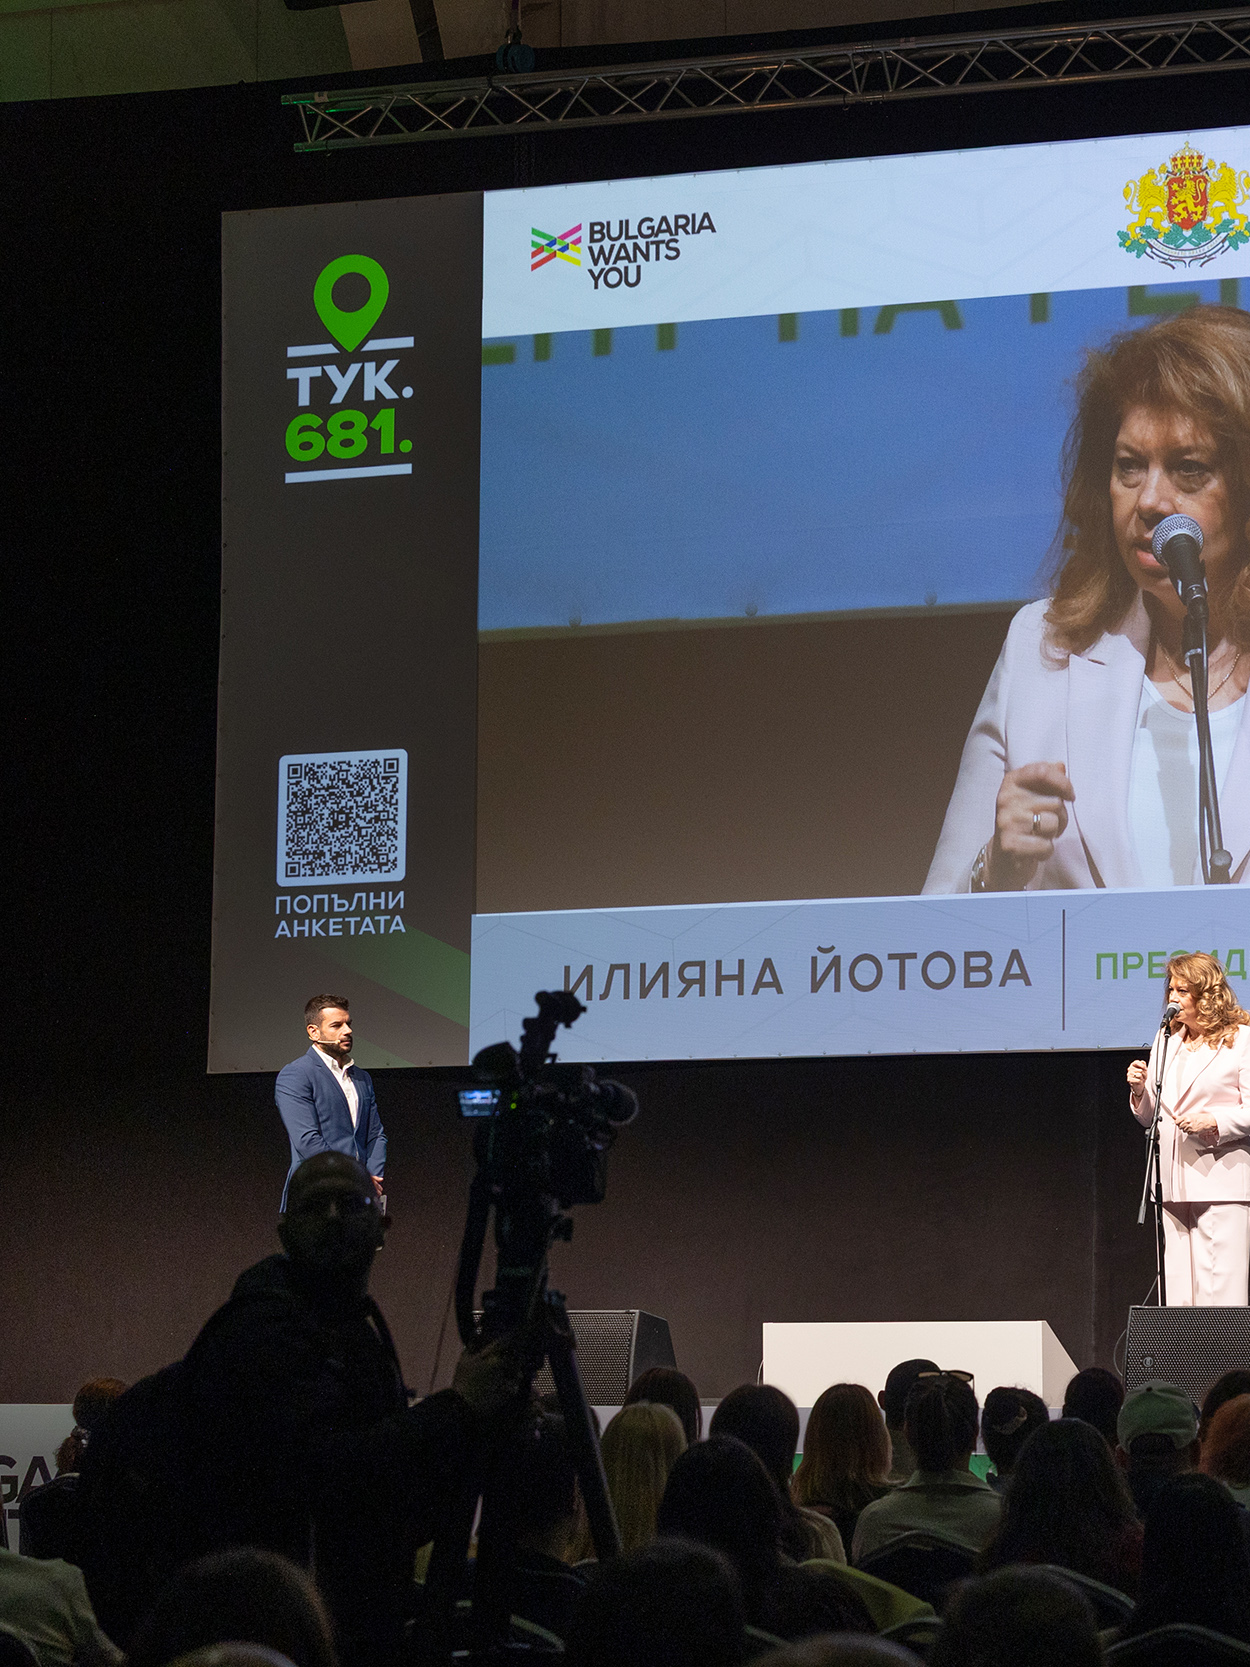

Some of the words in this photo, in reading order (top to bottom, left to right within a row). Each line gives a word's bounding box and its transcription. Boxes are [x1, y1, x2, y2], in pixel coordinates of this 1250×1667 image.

[588, 212, 717, 243] BULGARIA
[587, 238, 681, 267] WANTS
[587, 264, 642, 290] YOU
[286, 359, 414, 407] ТУК.
[285, 408, 413, 462] 681.
[275, 891, 405, 915] ПОПЪЛНИ
[274, 915, 406, 938] АНКЕТАТА
[563, 957, 784, 1001] ИЛИЯНА
[810, 945, 1033, 994] ЙОТОВА
